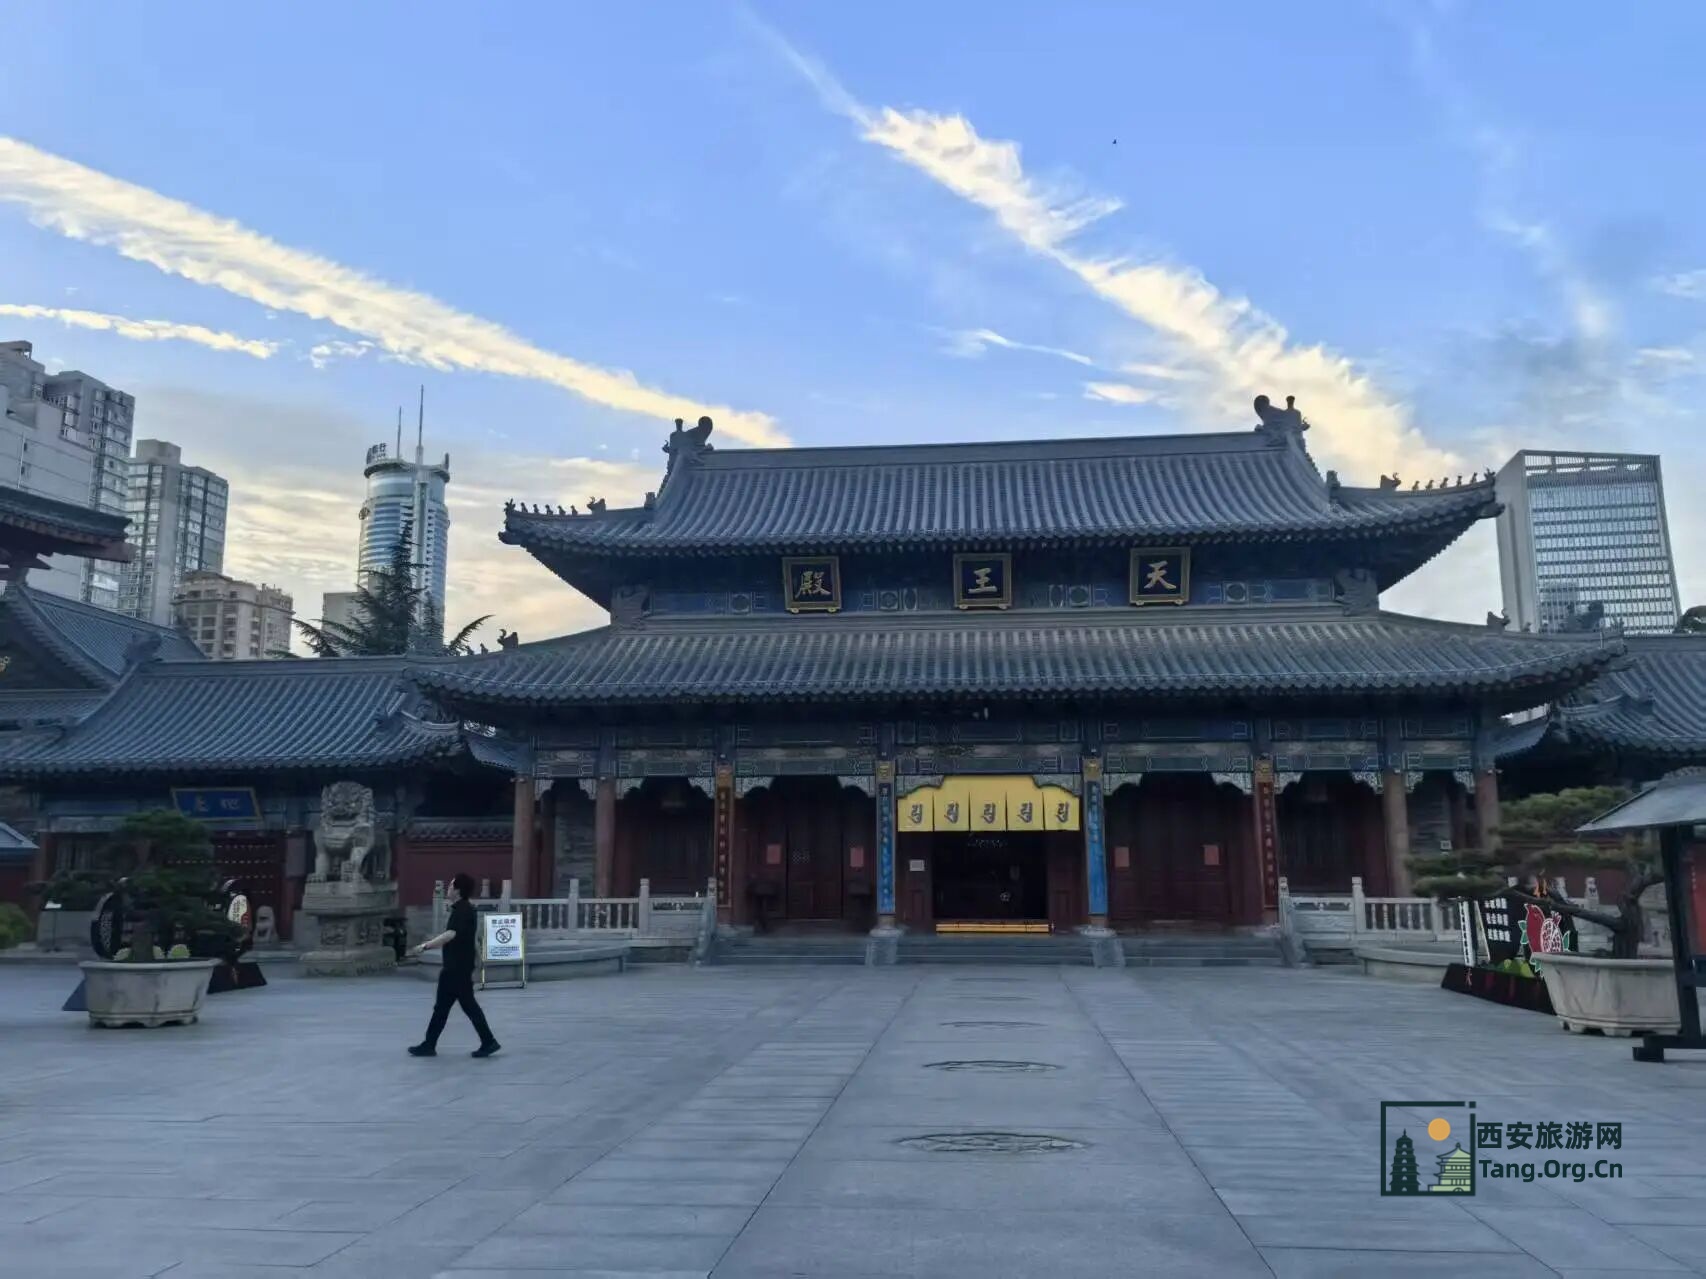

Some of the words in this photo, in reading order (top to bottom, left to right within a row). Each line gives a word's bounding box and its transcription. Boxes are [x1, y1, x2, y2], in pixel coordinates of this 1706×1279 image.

[795, 571, 831, 598] 殿
[970, 567, 997, 593] 王
[1144, 561, 1176, 590] 天
